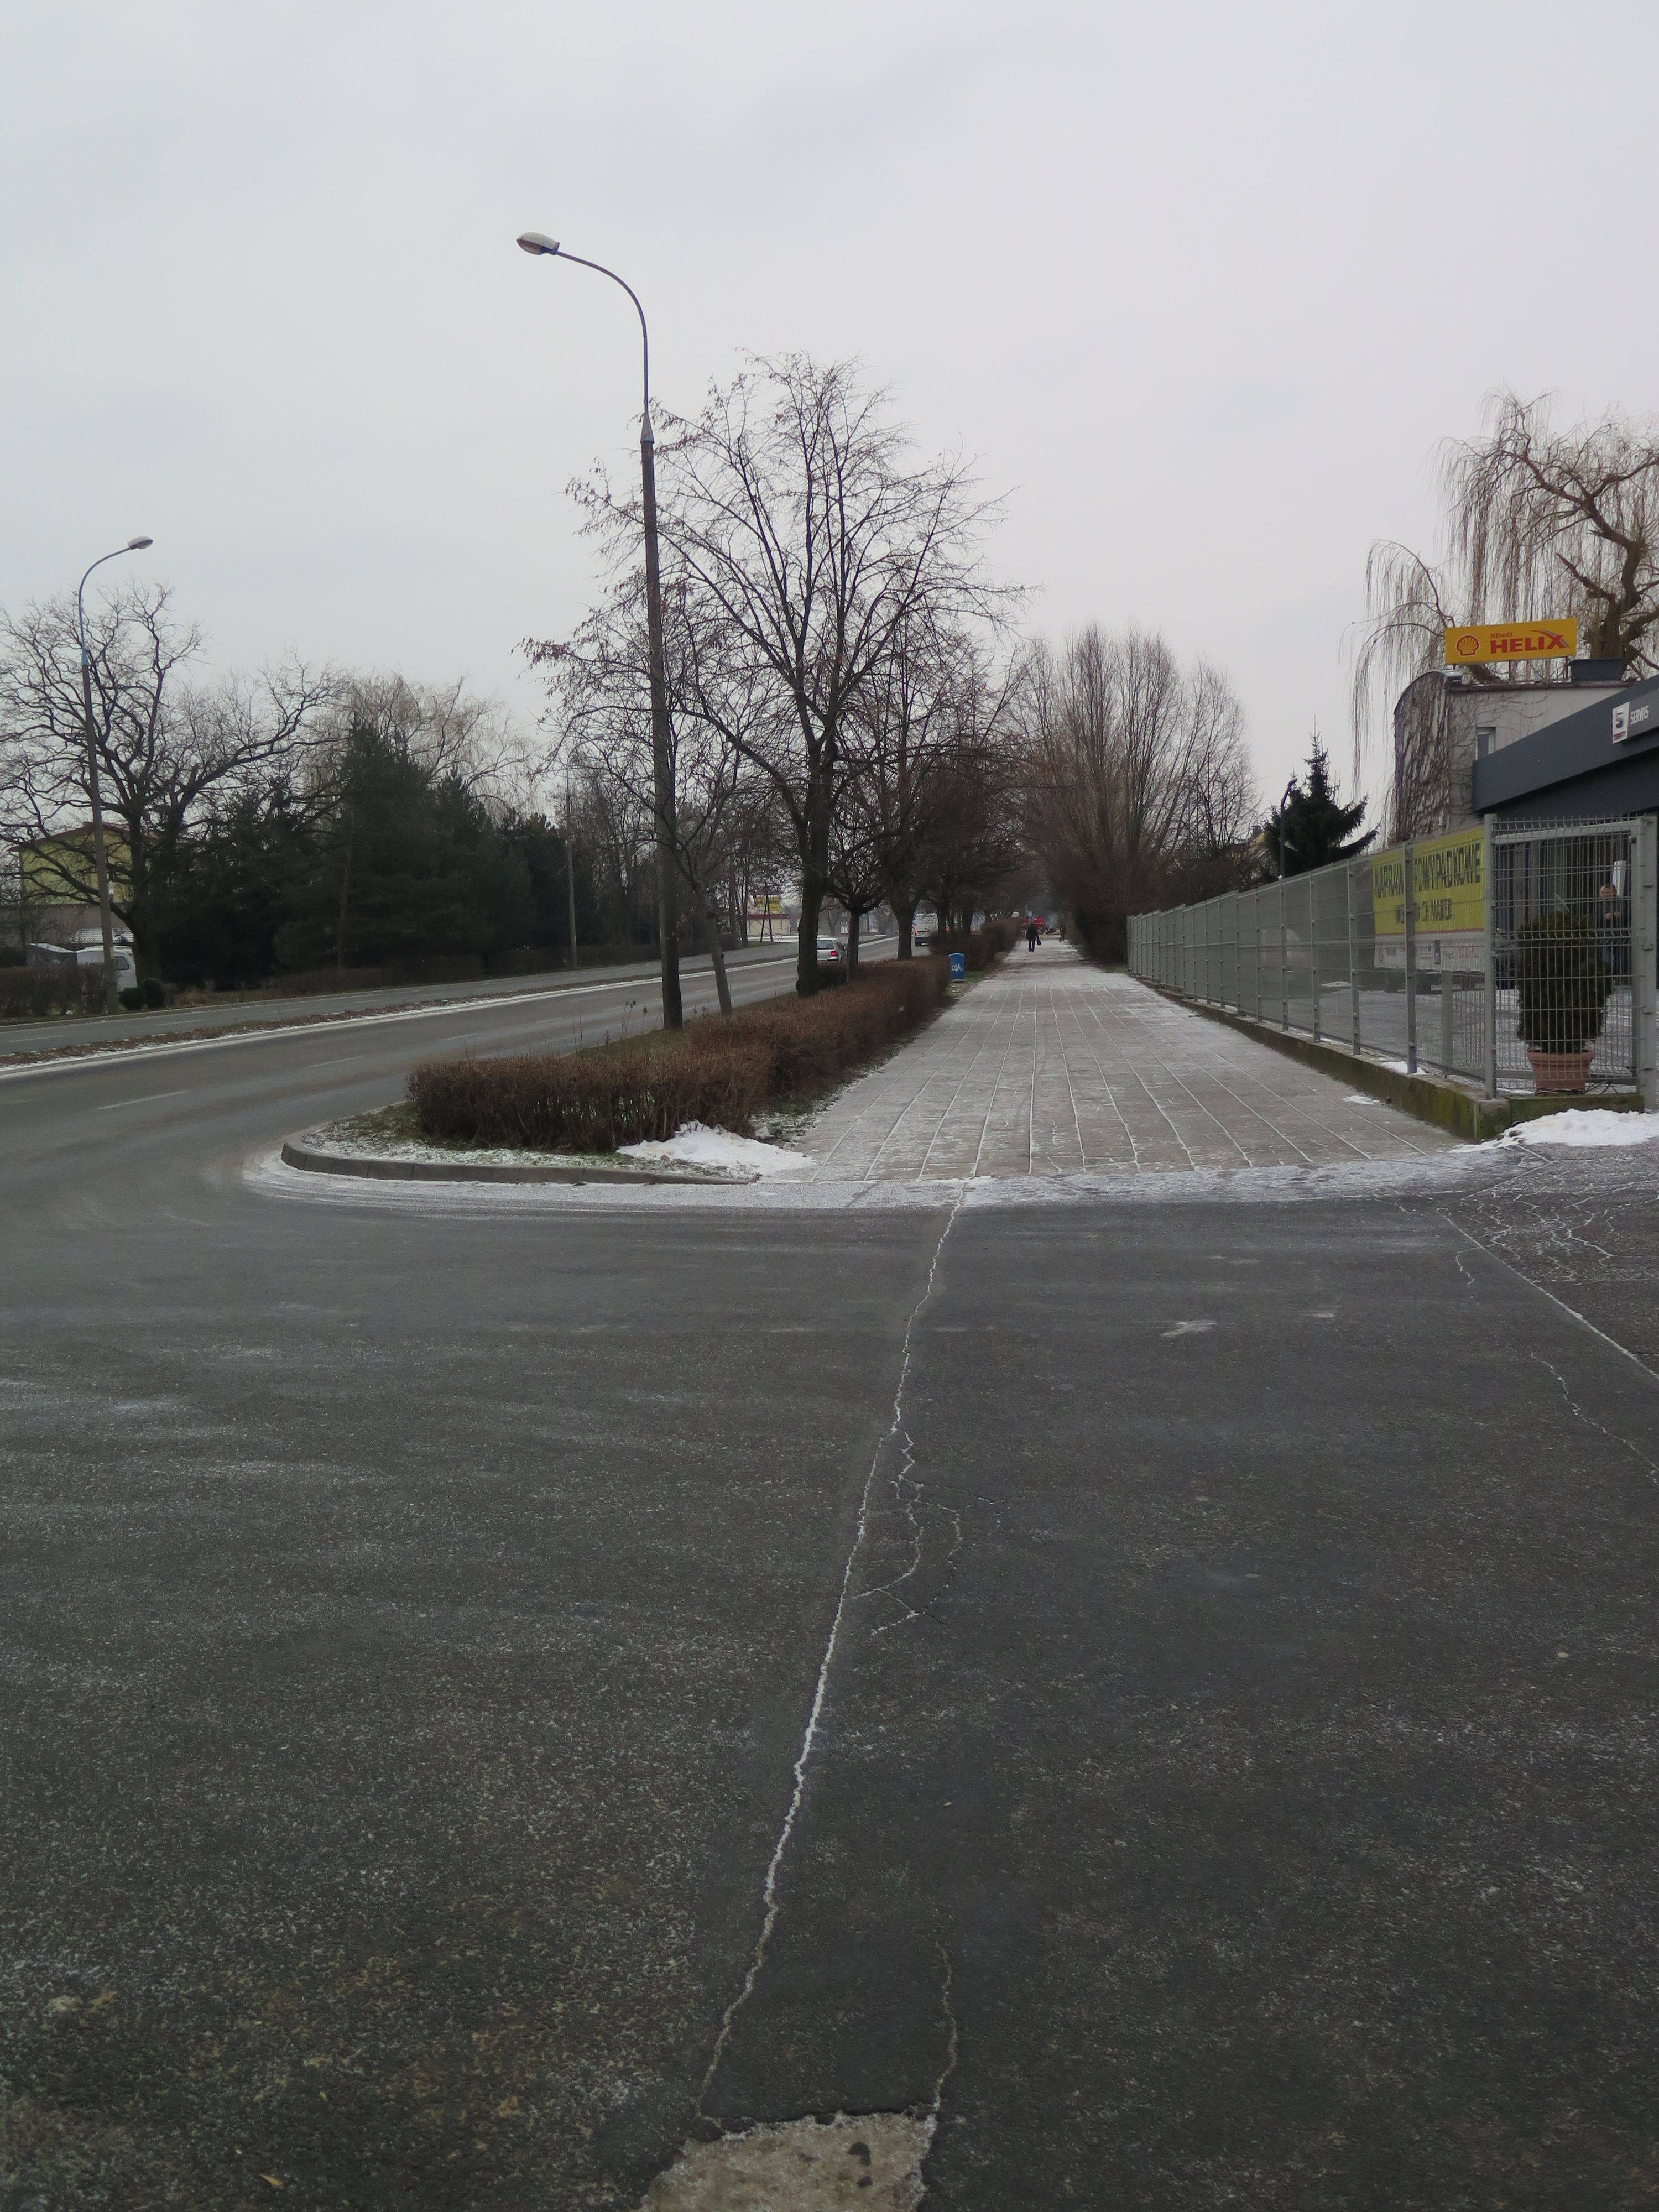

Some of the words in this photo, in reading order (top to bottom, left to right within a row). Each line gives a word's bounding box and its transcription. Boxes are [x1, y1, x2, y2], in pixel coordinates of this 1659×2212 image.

[1490, 633, 1569, 654] HELIX
[1630, 705, 1650, 725] SERWIS
[1374, 862, 1405, 899] NAPRAW
